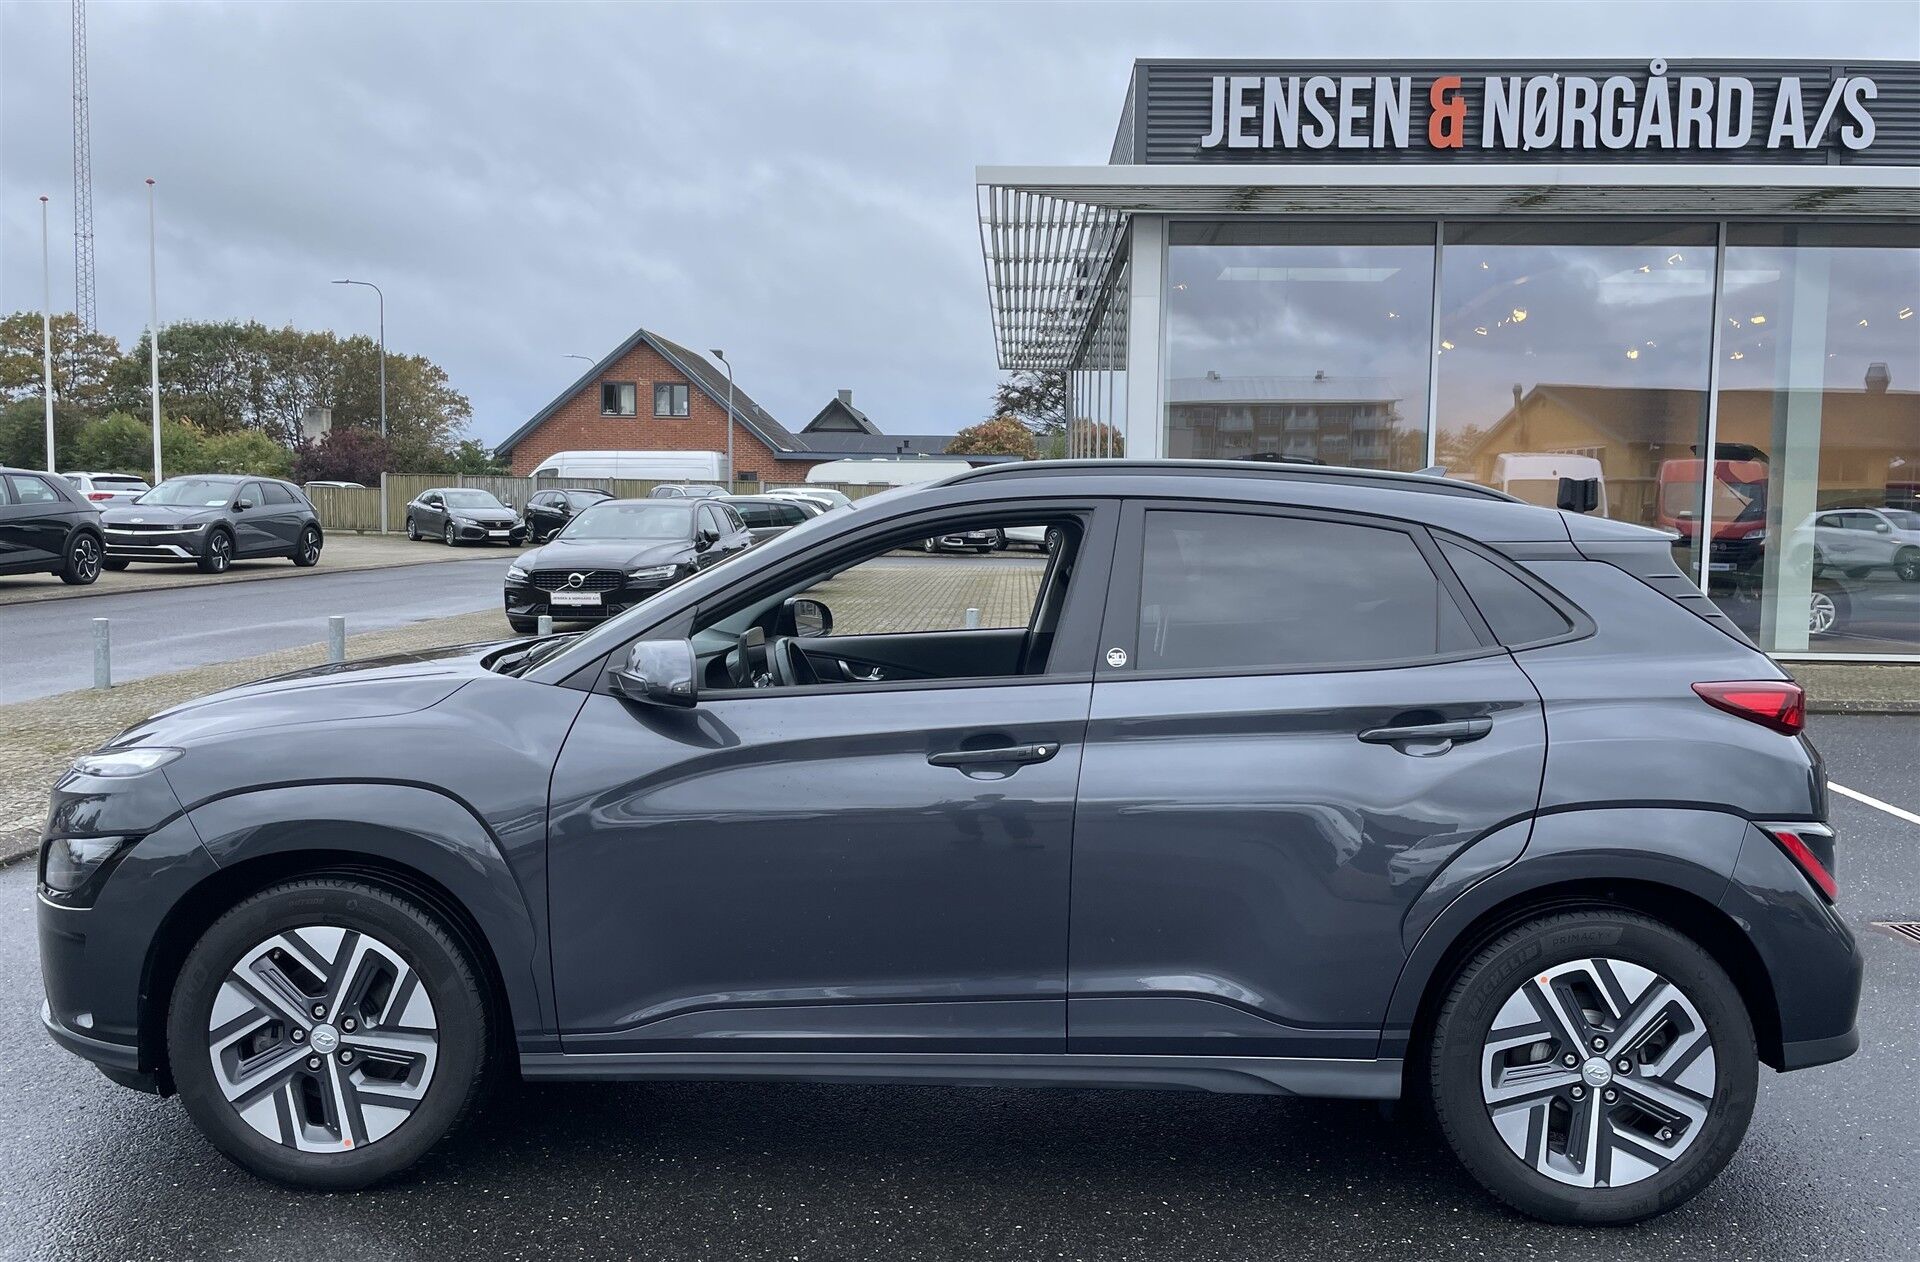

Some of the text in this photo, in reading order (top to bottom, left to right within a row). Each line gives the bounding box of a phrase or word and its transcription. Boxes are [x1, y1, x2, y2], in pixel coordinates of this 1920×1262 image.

[1201, 58, 1877, 151] JENSEN & NØRGÅRD A/S
[1551, 931, 1603, 947] PRIMACY
